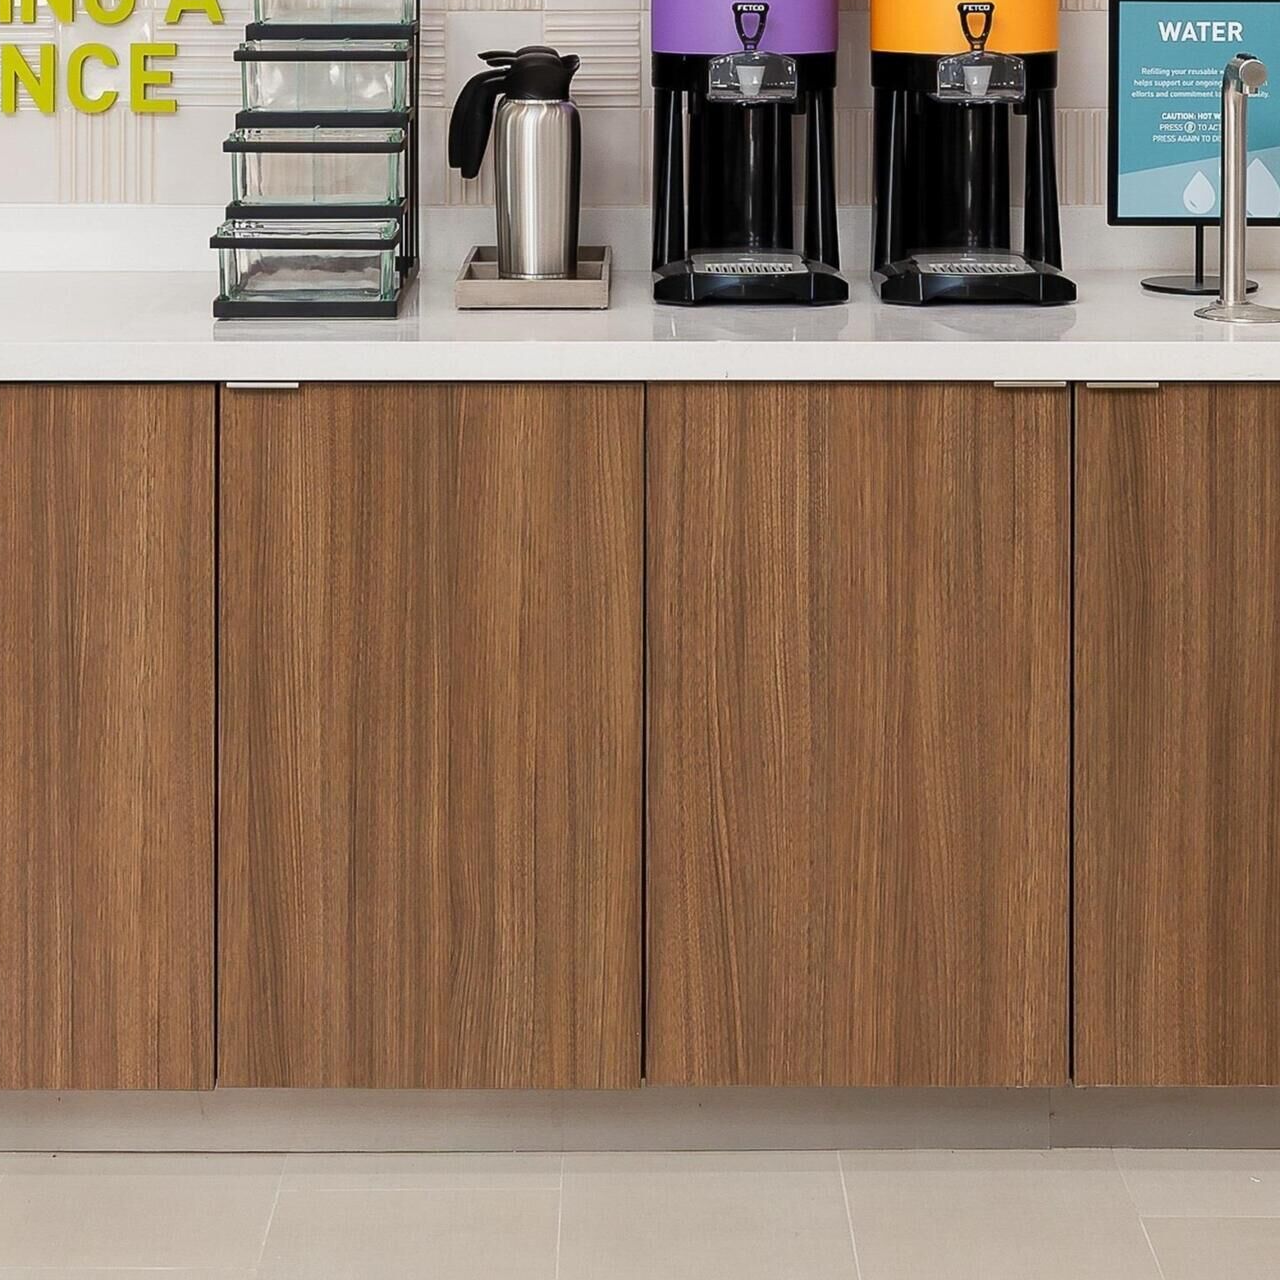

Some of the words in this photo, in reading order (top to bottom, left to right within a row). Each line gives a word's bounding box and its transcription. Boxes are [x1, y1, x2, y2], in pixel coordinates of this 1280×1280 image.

[737, 4, 765, 12] FETCO
[1158, 21, 1243, 42] WATER
[1141, 67, 1170, 77] Refilling
[1171, 69, 1187, 77] your
[1188, 67, 1218, 75] reusable
[1133, 79, 1153, 87] helps
[1154, 80, 1181, 88] support
[1194, 80, 1223, 88] ongoing
[1131, 90, 1154, 98] efforts
[1155, 90, 1169, 98] and
[1169, 90, 1214, 98] commitment
[1161, 112, 1197, 120] CAUTION:
[1197, 112, 1213, 120] HOT
[1159, 123, 1184, 131] PRESS
[1198, 123, 1207, 131] TO
